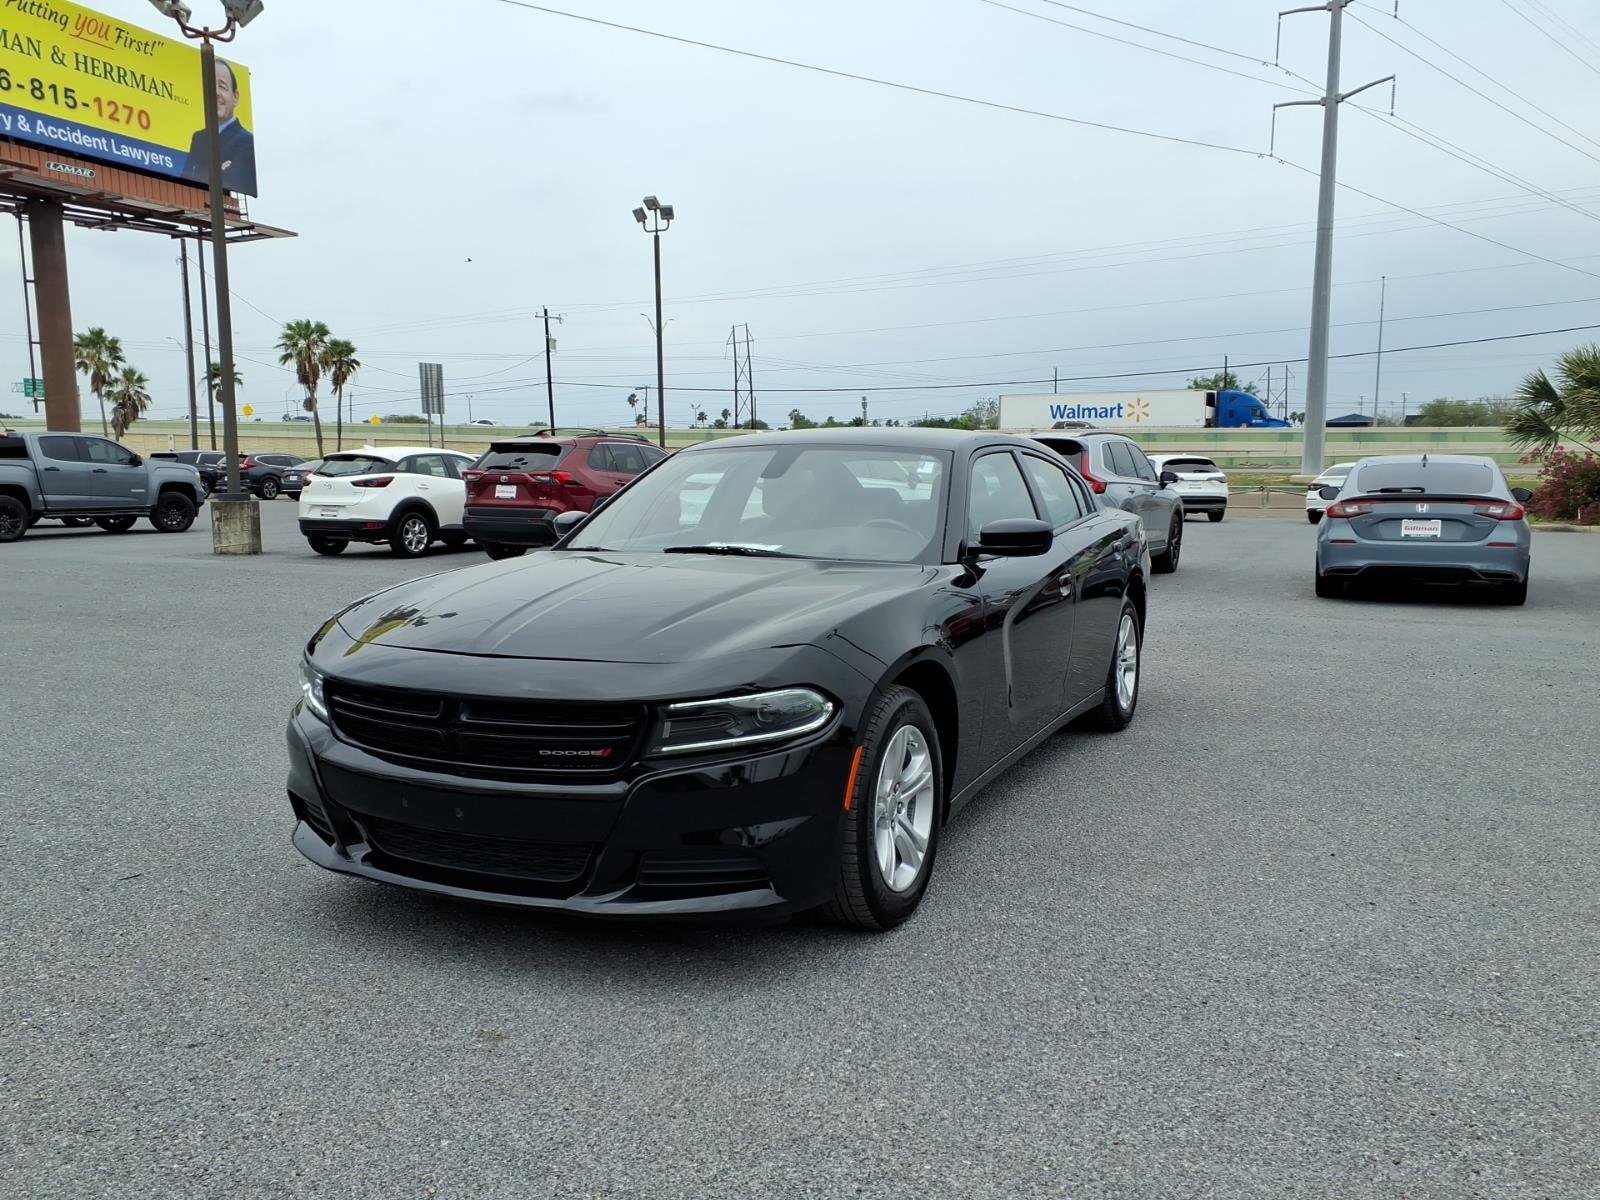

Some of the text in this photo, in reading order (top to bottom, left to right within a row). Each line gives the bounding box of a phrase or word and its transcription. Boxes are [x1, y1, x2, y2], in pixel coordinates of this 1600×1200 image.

[51, 45, 68, 67] &
[73, 51, 174, 100] HERRMAN
[17, 114, 32, 133] &
[36, 119, 109, 152] Accident
[111, 138, 173, 168] Lawyers
[49, 162, 92, 177] LAMAR
[1050, 403, 1123, 419] Walmart
